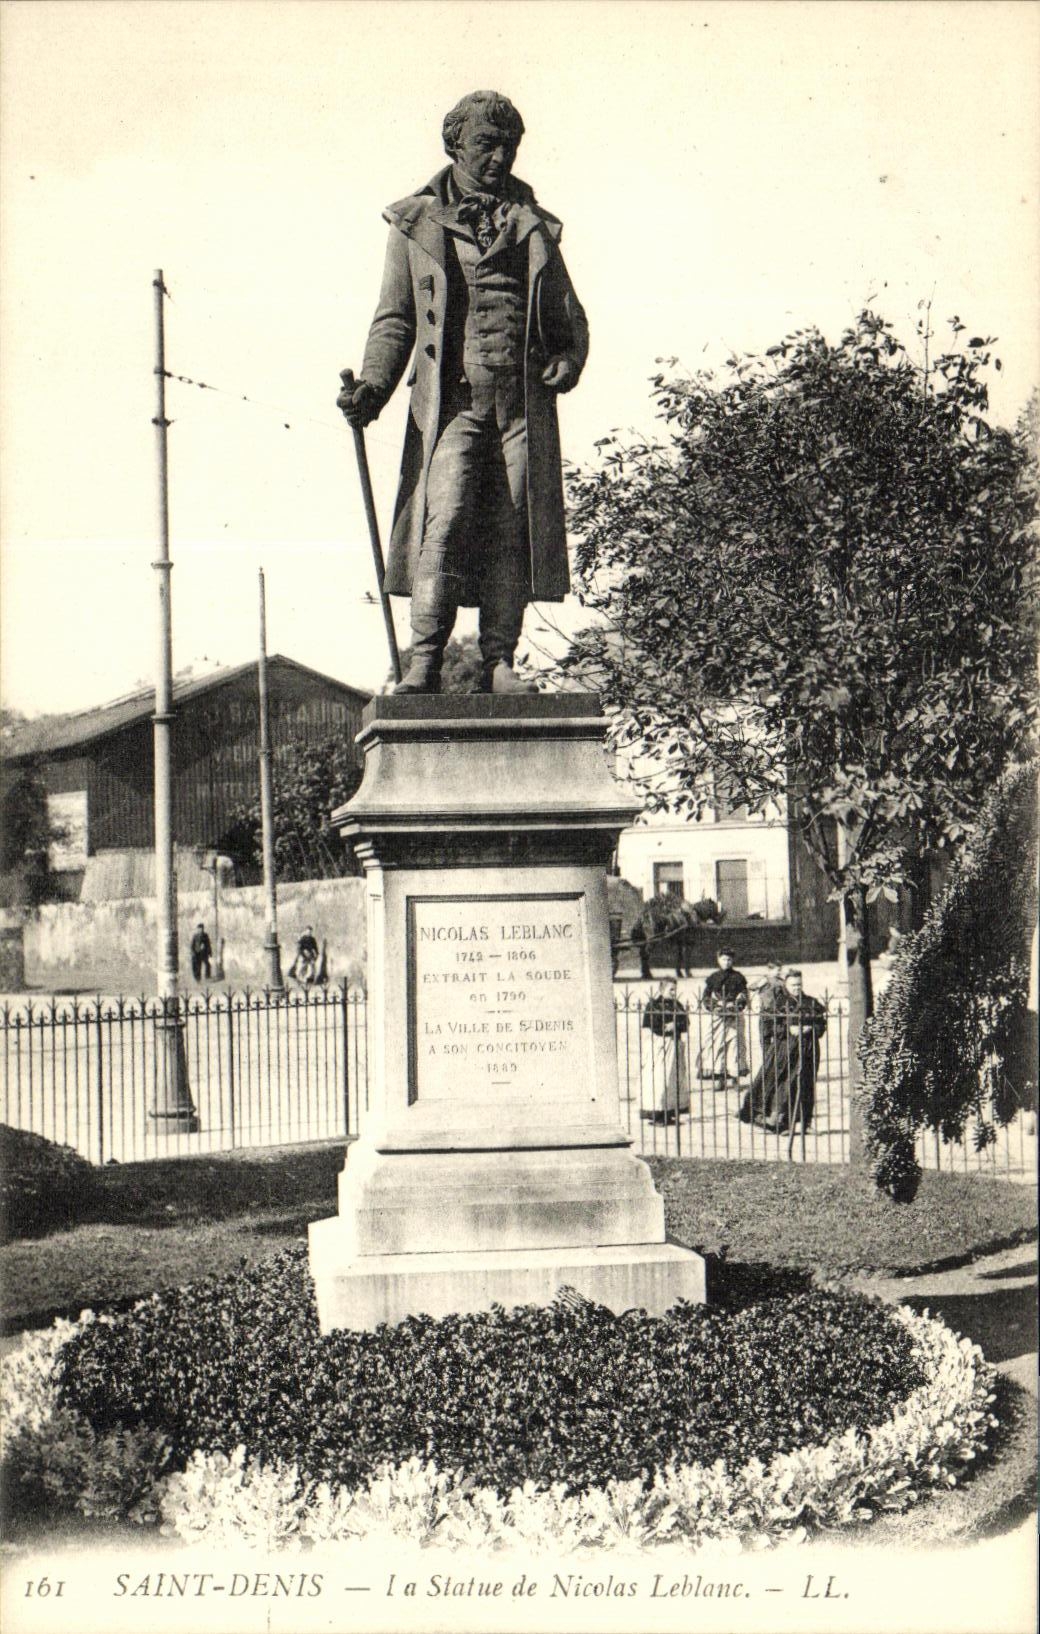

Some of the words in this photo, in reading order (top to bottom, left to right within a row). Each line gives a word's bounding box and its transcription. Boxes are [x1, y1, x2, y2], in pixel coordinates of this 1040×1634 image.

[420, 926, 490, 942] NICOLAS
[501, 924, 574, 940] LEBLANC
[506, 950, 537, 962] 1806
[422, 972, 488, 984] EXTRAIT
[497, 971, 516, 983] LA
[525, 969, 572, 981] SOUDE
[496, 991, 527, 1002] 1790
[442, 1043, 469, 1055] SON
[476, 1040, 569, 1054] CONCITOYEN
